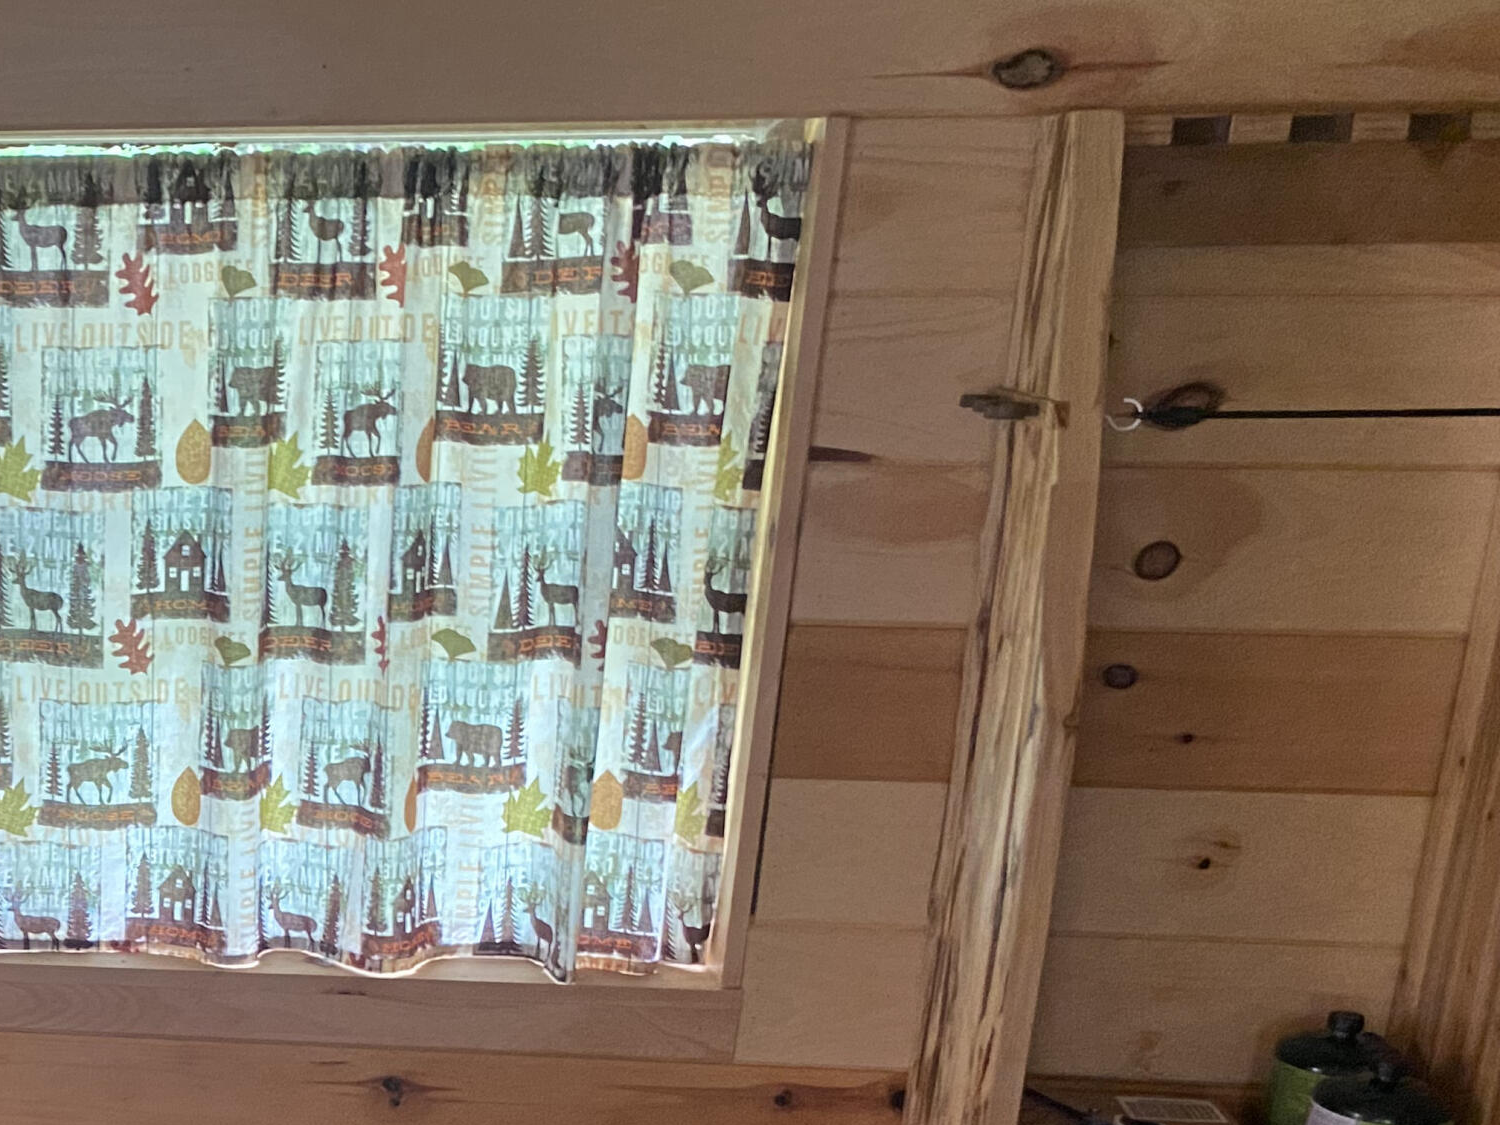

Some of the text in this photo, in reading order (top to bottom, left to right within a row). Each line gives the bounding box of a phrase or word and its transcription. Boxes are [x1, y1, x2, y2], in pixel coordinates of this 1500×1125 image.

[277, 272, 352, 286] DEER
[16, 322, 68, 352] LIVE
[300, 315, 345, 344] LIVE
[444, 420, 520, 434] BEAR
[60, 470, 142, 481] MOOSE
[243, 527, 264, 622] SIMPLE
[467, 522, 496, 617] SIMPLE
[15, 676, 64, 705] LIVE
[279, 672, 325, 699] LIVE
[427, 771, 504, 784] BEAR
